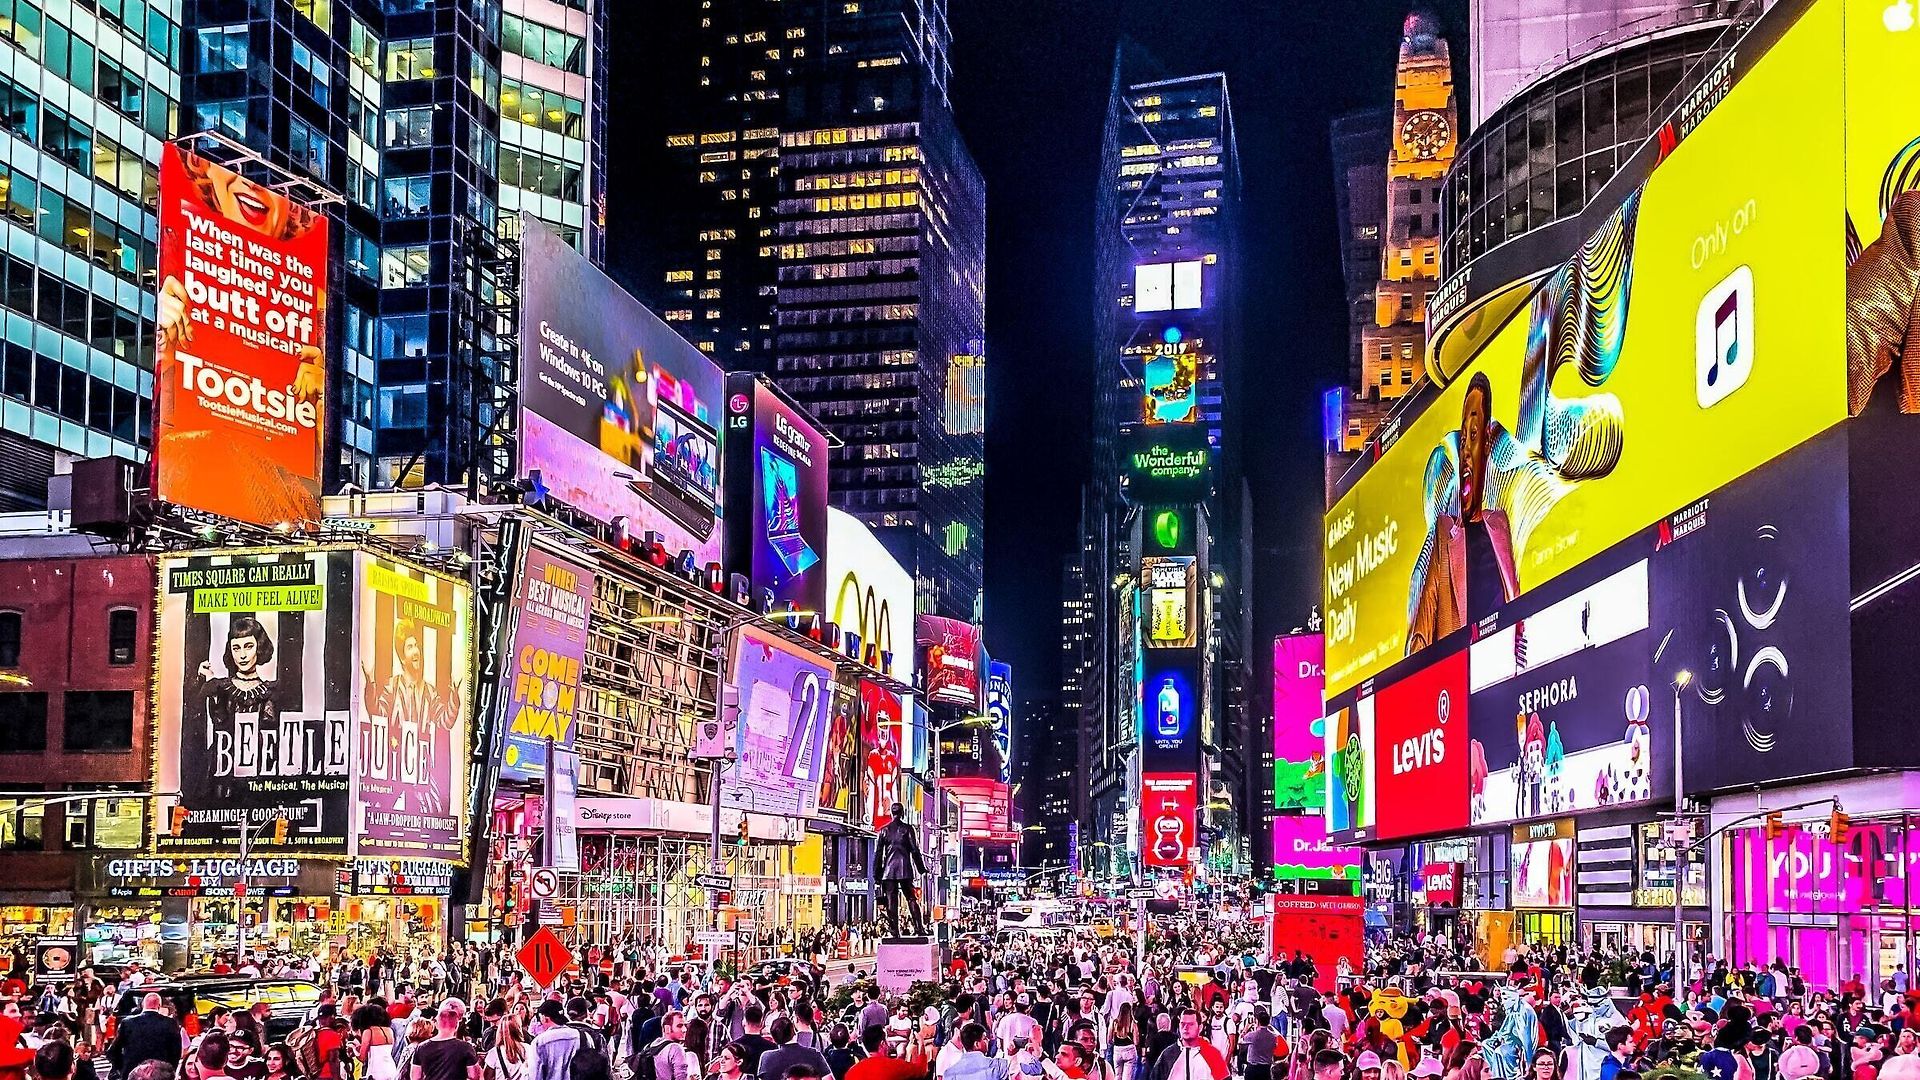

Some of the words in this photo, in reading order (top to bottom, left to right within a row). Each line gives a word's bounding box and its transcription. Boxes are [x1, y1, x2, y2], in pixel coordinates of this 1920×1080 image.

[1682, 52, 1737, 121] MARRIOTT
[1682, 81, 1730, 139] MARQUIS
[1691, 222, 1730, 269] Only
[1733, 199, 1756, 234] on
[186, 228, 223, 260] last
[230, 248, 274, 279] time
[279, 271, 313, 297] you
[248, 240, 282, 265] was
[285, 254, 313, 279] the
[185, 249, 267, 297] laughed
[270, 287, 313, 314] your
[1432, 267, 1473, 313] MARRIOTT
[185, 270, 260, 325] butt
[265, 309, 313, 343] off
[191, 307, 209, 325] at
[214, 315, 225, 330] a
[1432, 288, 1466, 331] MARQUIS
[540, 320, 569, 353] Create
[570, 340, 579, 359] in
[592, 360, 604, 376] on
[1155, 343, 1188, 356] 2019
[540, 342, 580, 382] Windows
[581, 371, 591, 390] 10
[592, 377, 607, 400] PCs
[175, 350, 316, 428] Tootsie
[197, 396, 298, 435] TootsieMusical.com
[730, 415, 748, 429] LG
[776, 412, 788, 435] LG
[1135, 451, 1203, 468] Wonderful
[1152, 446, 1168, 456] the
[1152, 467, 1195, 478] company
[1673, 499, 1710, 526] MARRIOTT
[1673, 513, 1705, 538] MARQUIS
[1328, 557, 1355, 605] New
[1356, 515, 1398, 582] Music
[173, 571, 203, 588] TIMES
[206, 568, 246, 587] SQUARE
[249, 566, 269, 582] CAN
[272, 563, 312, 581] REALLY
[545, 562, 578, 592] WINNER!
[198, 592, 228, 608] MAKE
[232, 591, 252, 606] YOU
[256, 591, 282, 603] FEEL
[286, 589, 320, 605] ALIVE!
[528, 578, 551, 606] BEST
[551, 586, 586, 619] MUSICAL
[403, 600, 413, 617] ON
[414, 604, 450, 628] BROADWAY!
[1328, 598, 1358, 649] Daily
[520, 643, 579, 685] COME
[514, 674, 577, 712] FROM
[1518, 676, 1578, 714] SEPHORA
[510, 704, 573, 743] AWAY
[214, 712, 349, 778] BEETLE
[359, 716, 430, 785] JUICE
[248, 781, 263, 792] The
[300, 780, 316, 791] The
[183, 807, 248, 824] CREAMINGLY
[579, 807, 612, 824] Disney
[612, 812, 632, 820] store
[1529, 822, 1557, 838] INVICTA
[109, 859, 174, 878] GIFTS
[190, 859, 299, 878] LUGGAGE
[354, 860, 391, 876] GIFTS
[400, 860, 453, 877] LUGGAGE
[1376, 859, 1391, 883] BIG
[1771, 851, 1831, 879] YOU
[168, 888, 198, 896] Canon
[205, 888, 235, 896] SONY
